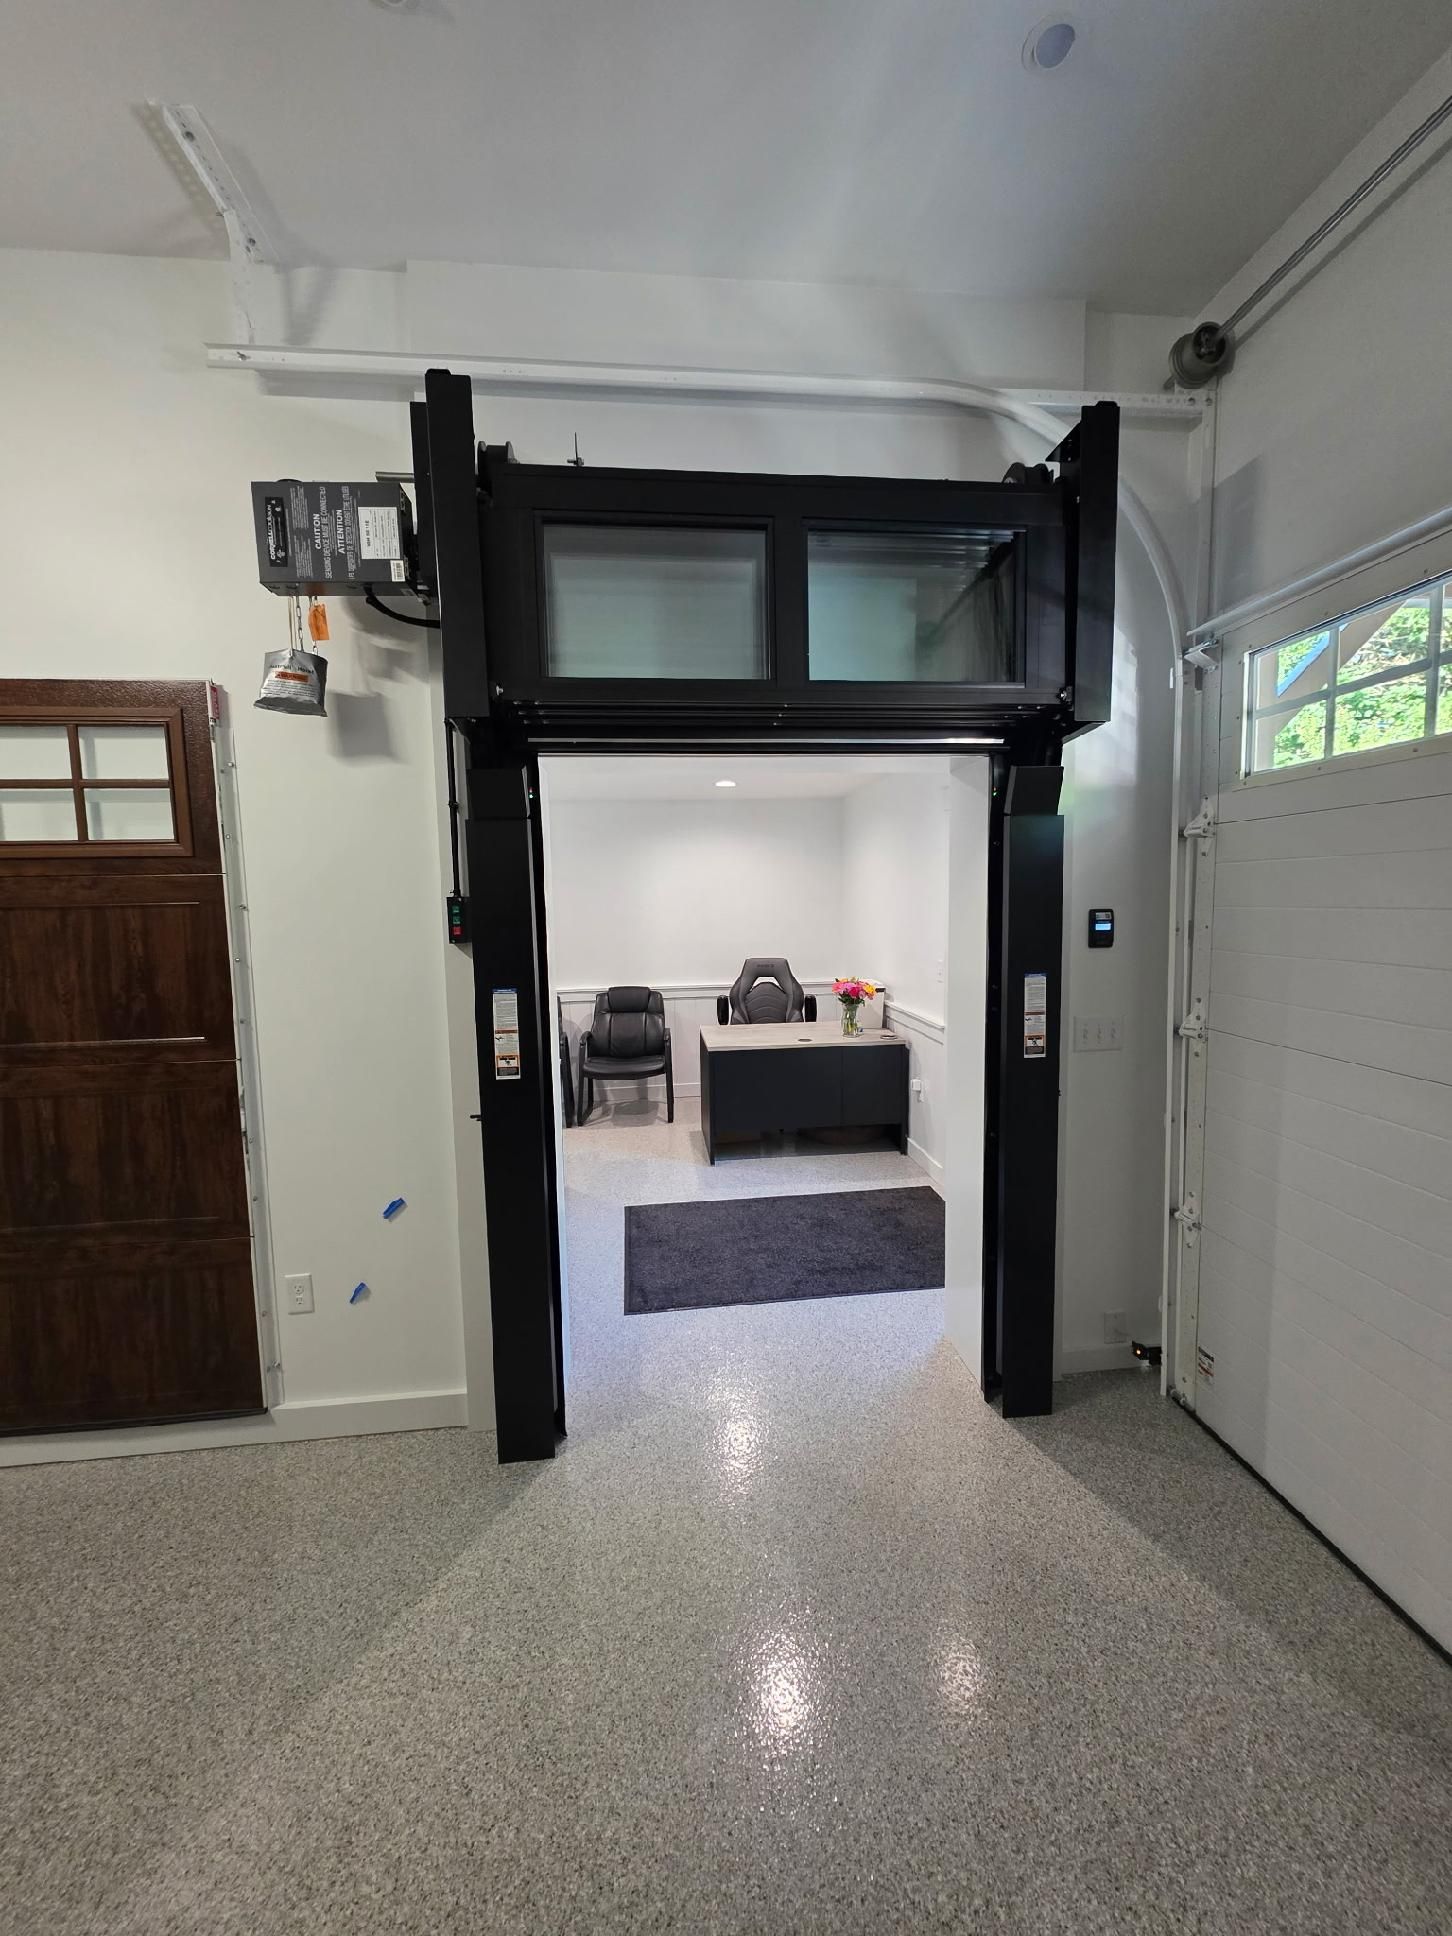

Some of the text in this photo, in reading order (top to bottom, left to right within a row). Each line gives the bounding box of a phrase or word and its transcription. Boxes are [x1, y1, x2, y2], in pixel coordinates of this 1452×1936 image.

[313, 513, 321, 549] CAUTION
[321, 525, 329, 538] MUST
[336, 509, 345, 554] ATTENTION
[322, 538, 330, 556] DEVICE
